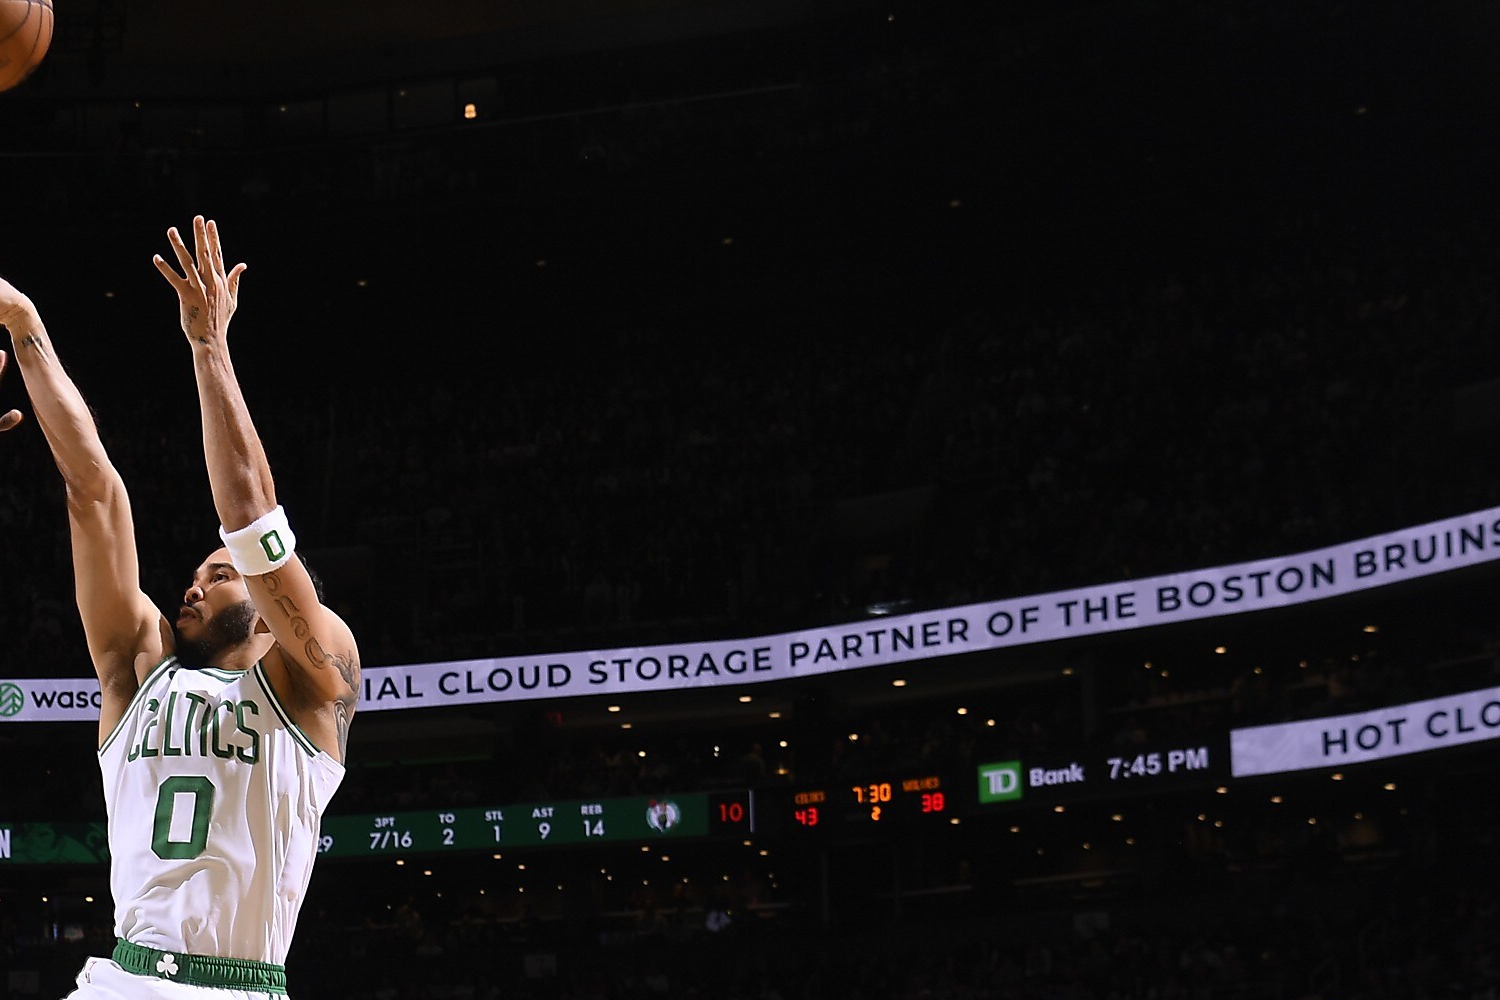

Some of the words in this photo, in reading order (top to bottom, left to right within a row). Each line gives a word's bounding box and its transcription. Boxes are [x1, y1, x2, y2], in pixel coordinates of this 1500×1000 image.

[364, 675, 424, 702] IAL
[438, 663, 572, 696] CLOUD
[588, 646, 772, 685] STORAGE
[789, 617, 970, 667] PARTNER
[985, 606, 1040, 637] OF
[1056, 592, 1137, 627] THE
[1157, 559, 1336, 613] BOSTON
[127, 691, 260, 765] CELTICS
[1322, 718, 1409, 756] HOT
[981, 769, 1017, 795] TD
[1029, 763, 1085, 788] Bank
[1107, 753, 1162, 780] 7:45
[1168, 747, 1209, 773] PM
[852, 783, 892, 804] 7:30
[921, 793, 945, 812] 38
[151, 776, 216, 861] 0
[374, 817, 395, 828] 3PT
[439, 813, 455, 824] TO
[485, 811, 503, 822] STL
[532, 807, 554, 818] AST
[719, 803, 744, 822] 10
[795, 807, 819, 826] 43
[369, 830, 412, 850] 7/16
[442, 828, 455, 846] 2
[493, 825, 501, 842] 1
[538, 821, 551, 840] 9
[583, 820, 605, 837] 14
